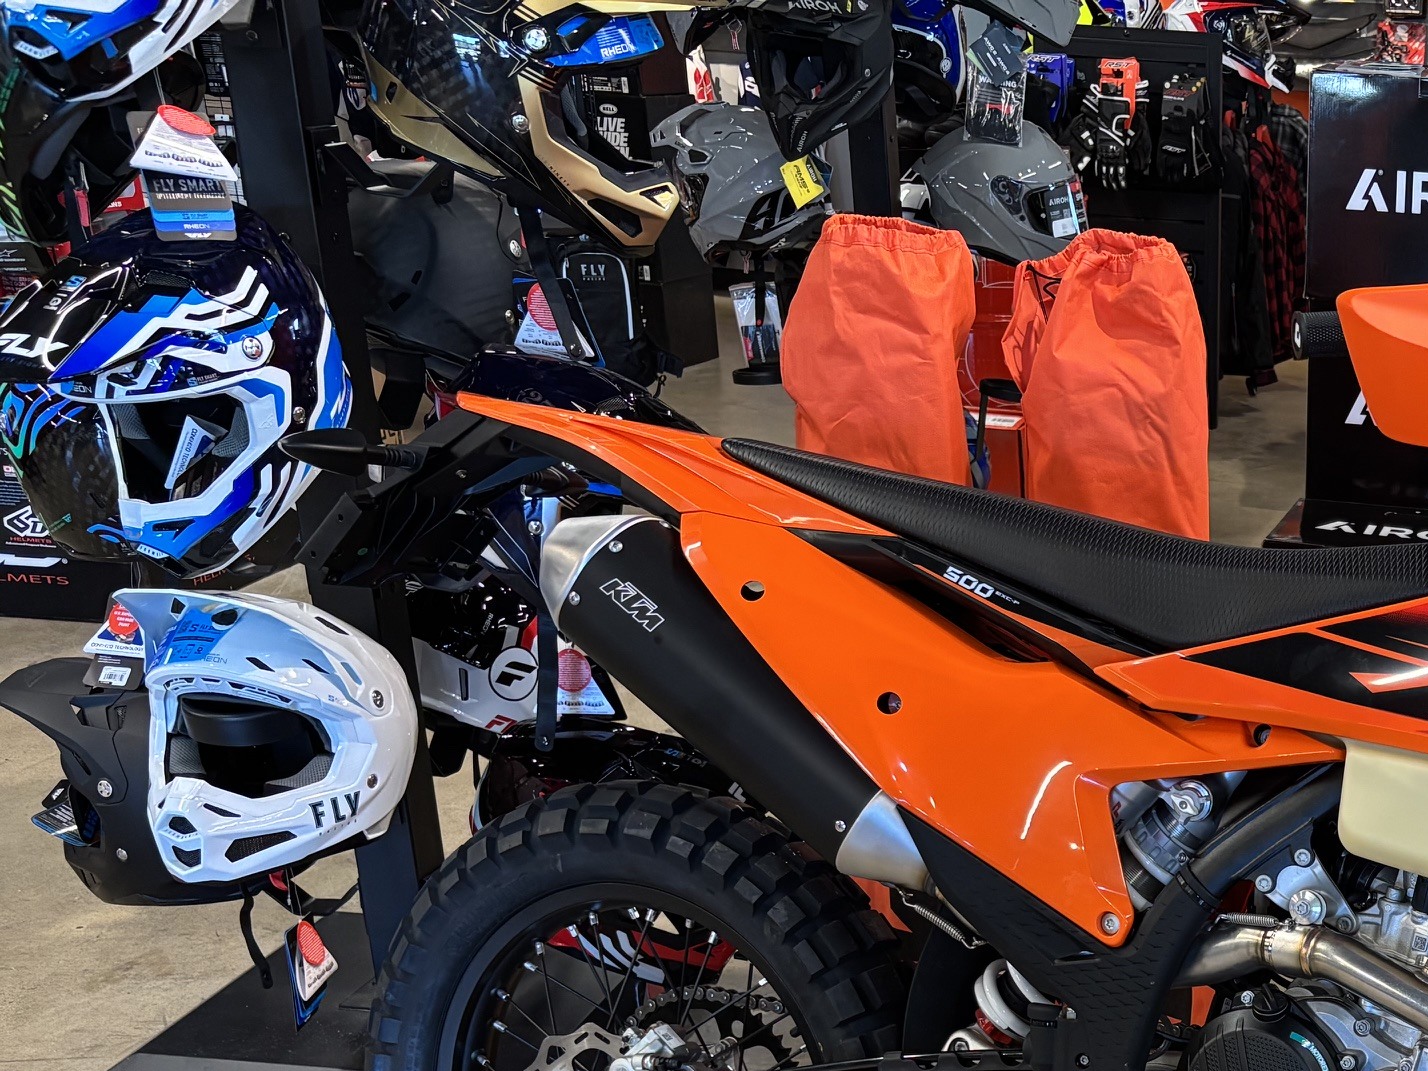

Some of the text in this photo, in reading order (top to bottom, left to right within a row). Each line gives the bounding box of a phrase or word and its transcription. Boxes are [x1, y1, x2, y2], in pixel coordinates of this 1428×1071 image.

[1104, 61, 1138, 70] RST
[978, 74, 1018, 88] WAING
[596, 116, 626, 132] LIVE
[602, 132, 630, 147] IDE
[153, 179, 175, 192] FLY
[580, 264, 606, 276] FLY
[9, 536, 52, 544] HELMETS
[943, 566, 995, 598] 500
[598, 578, 665, 632] KTM
[308, 790, 361, 829] FLY
